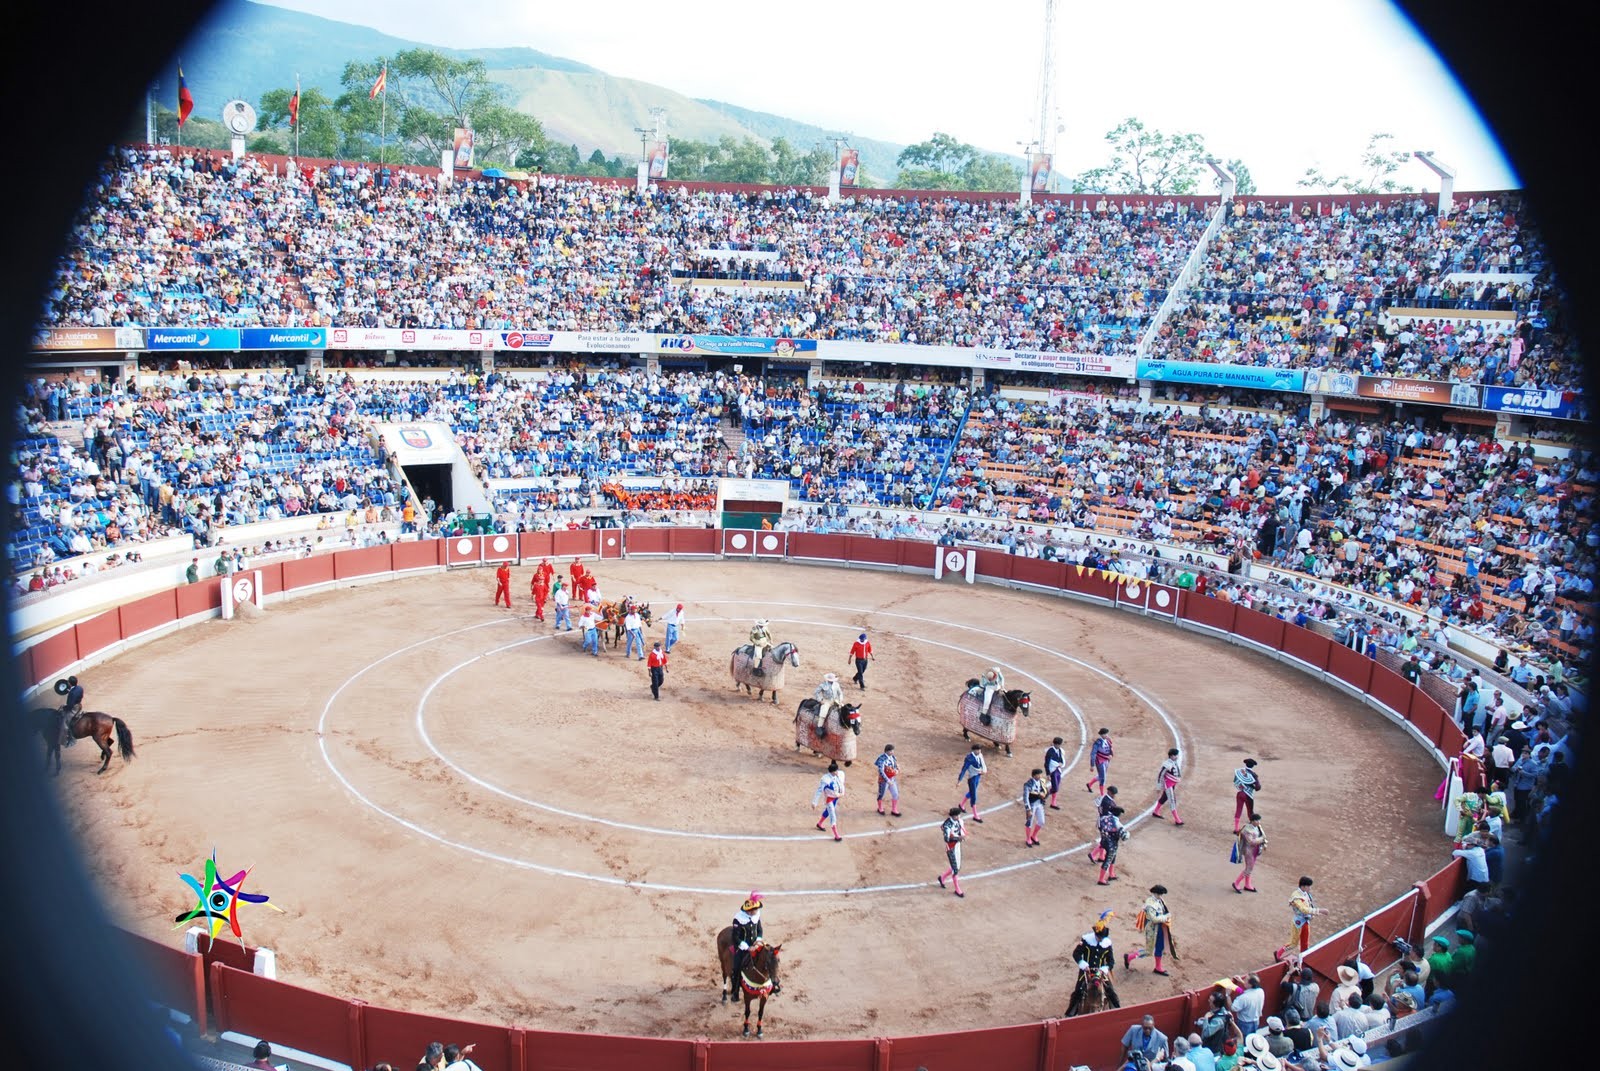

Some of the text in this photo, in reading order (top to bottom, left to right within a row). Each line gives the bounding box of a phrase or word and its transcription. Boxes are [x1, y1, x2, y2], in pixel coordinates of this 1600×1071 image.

[54, 332, 64, 340] La
[154, 333, 197, 343] Mercantil
[269, 333, 310, 343] Mercantil
[1014, 352, 1037, 360] Declarar
[1075, 362, 1085, 371] 31
[1172, 369, 1193, 377] AGUA
[1193, 370, 1213, 378] PURA
[1225, 373, 1265, 382] MANANTIAL
[1394, 382, 1435, 393] La Auténtica
[1394, 390, 1420, 398] cerveza
[950, 554, 958, 569] 4
[239, 582, 249, 602] 3
